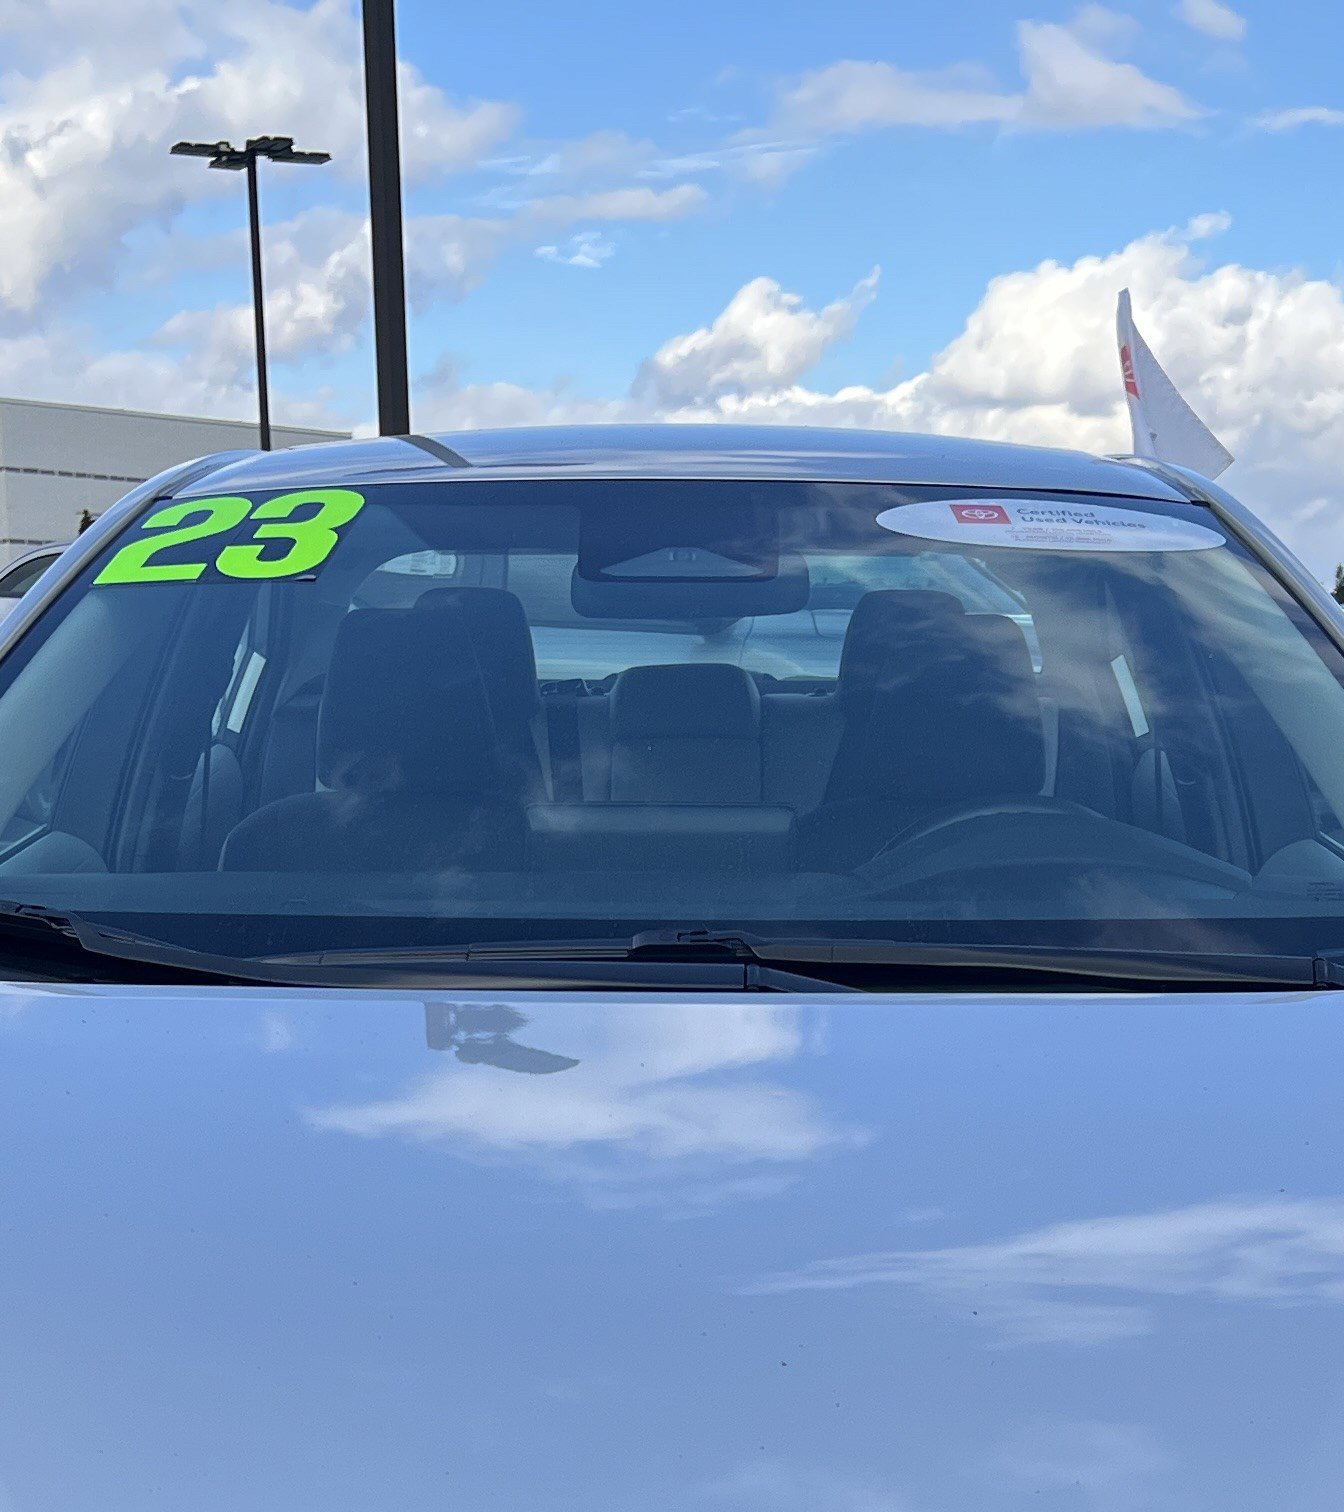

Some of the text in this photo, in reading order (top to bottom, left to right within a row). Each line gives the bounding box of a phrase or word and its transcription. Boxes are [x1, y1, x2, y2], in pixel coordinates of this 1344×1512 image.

[1016, 508, 1095, 518] Certified
[1071, 518, 1146, 528] Vehicles
[93, 489, 366, 585] 23
